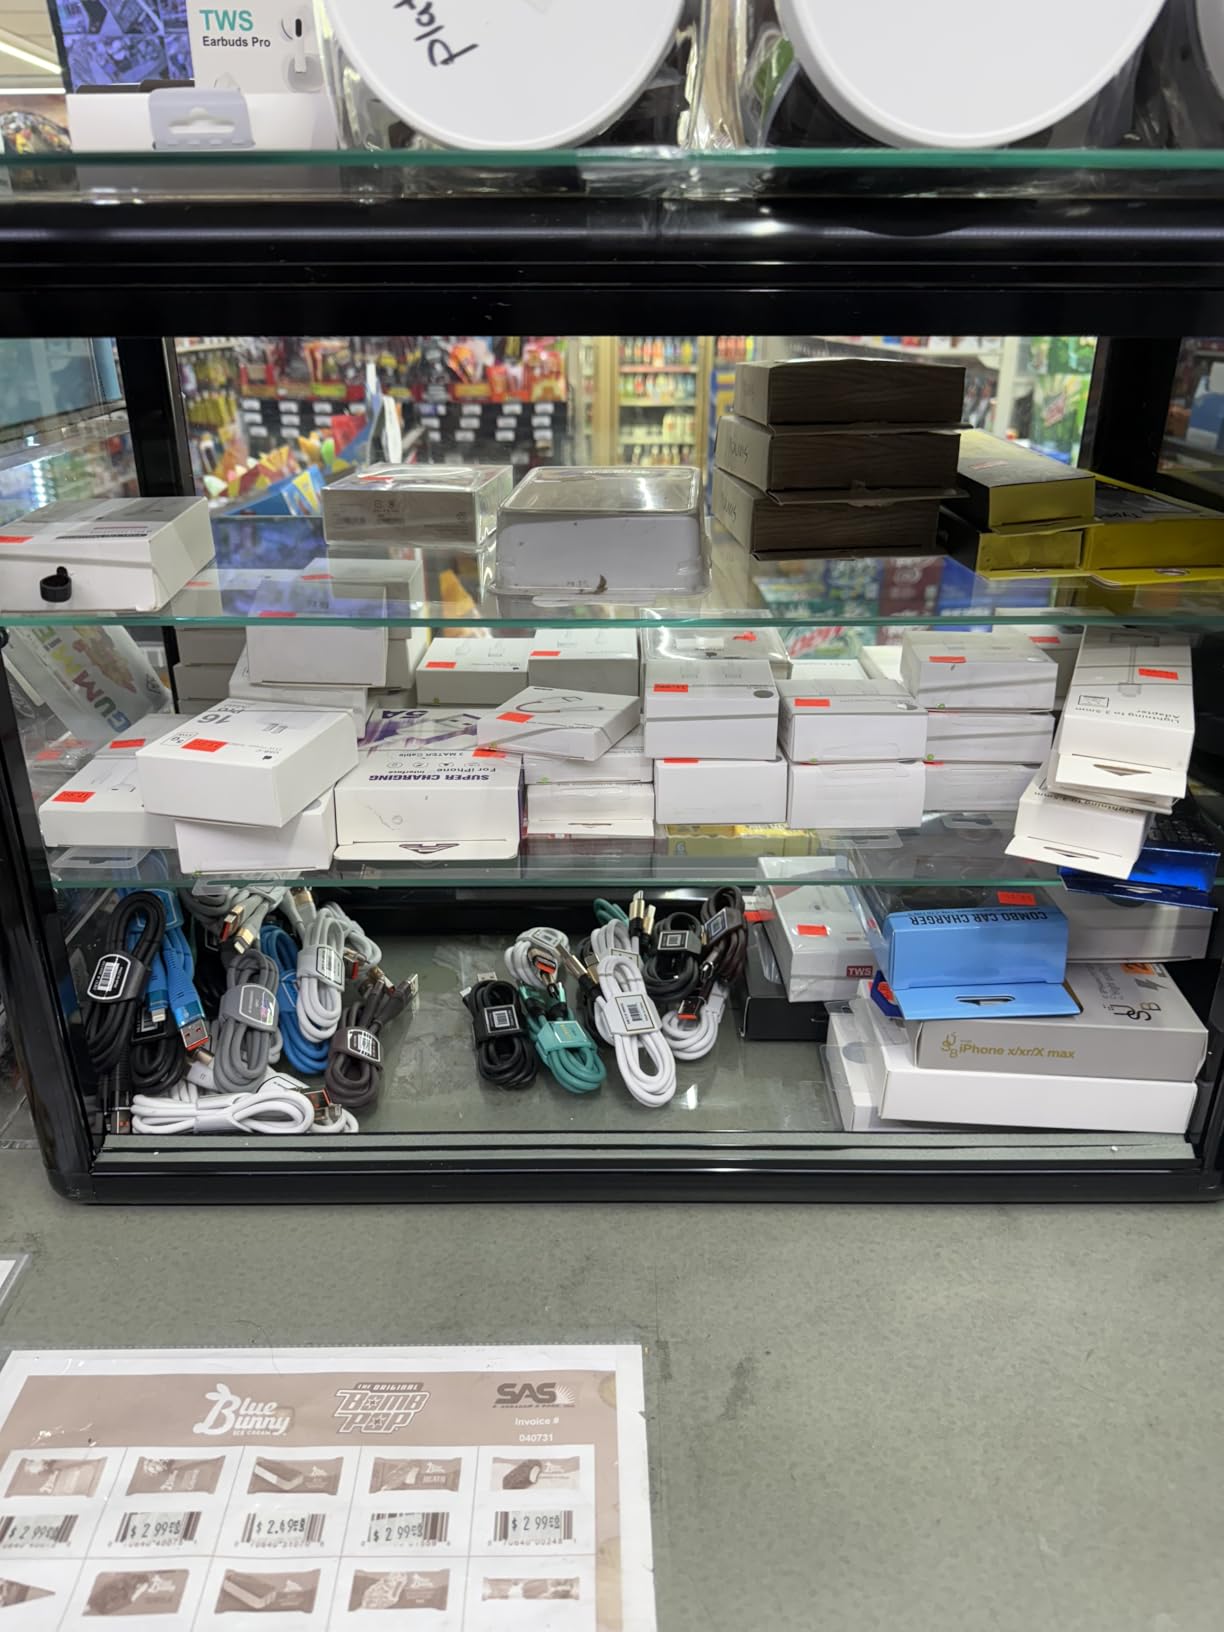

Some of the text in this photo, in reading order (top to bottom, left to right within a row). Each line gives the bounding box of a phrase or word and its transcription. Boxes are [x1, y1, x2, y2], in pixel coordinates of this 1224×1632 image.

[199, 9, 254, 31] TWS
[202, 36, 271, 47] Earbuds Pro
[198, 713, 231, 725] 16
[382, 710, 429, 719] 5A
[1127, 712, 1180, 724] Lightning
[910, 914, 971, 926] CHARGER
[972, 913, 1001, 923] CAR
[1001, 910, 1049, 922] COMBO
[847, 967, 872, 976] TWS
[959, 1043, 1075, 1060] iPhone x/xr/X max
[372, 1383, 419, 1391] ORIGINAL
[494, 1382, 557, 1405] SAS
[515, 1417, 551, 1426] Invoice
[519, 1434, 553, 1442] 040731
